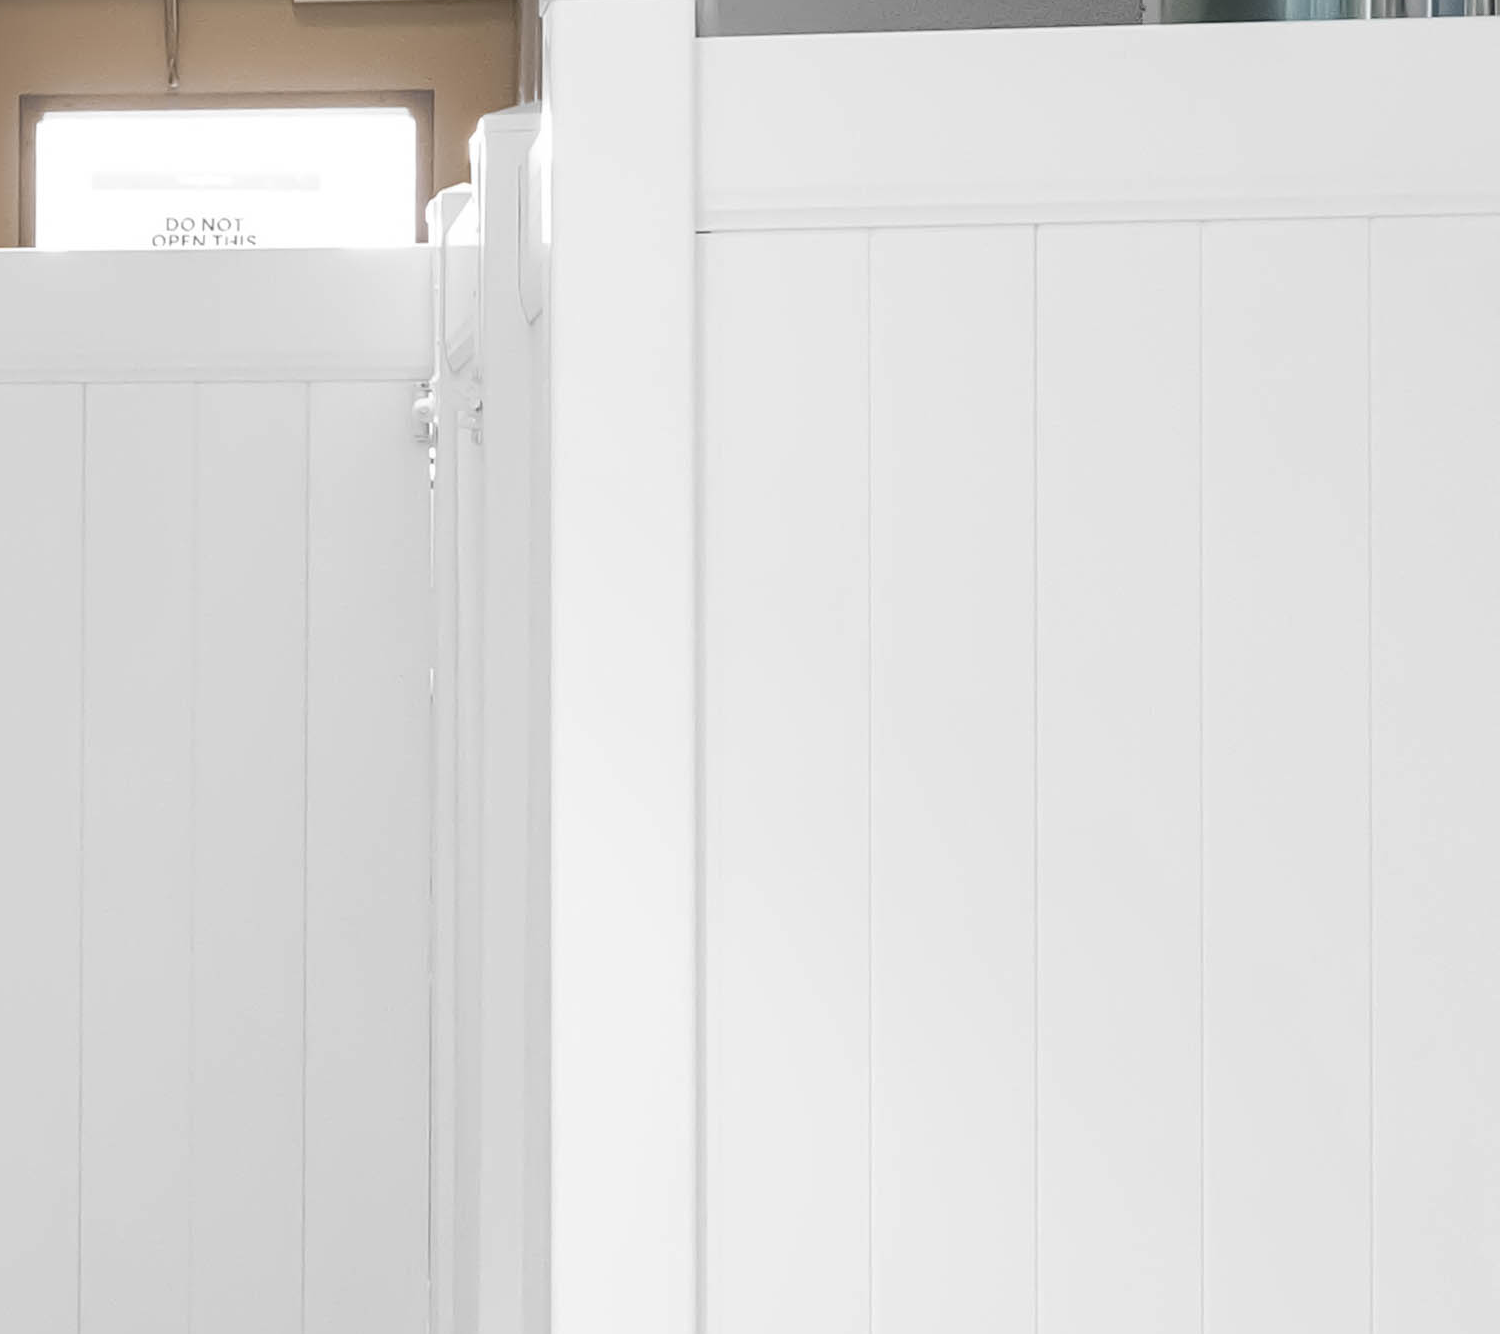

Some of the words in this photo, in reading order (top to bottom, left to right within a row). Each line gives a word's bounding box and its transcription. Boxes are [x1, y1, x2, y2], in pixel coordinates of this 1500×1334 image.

[166, 217, 195, 232] DO
[202, 217, 244, 232] NOT
[152, 234, 206, 247] OPEN
[213, 234, 257, 247] THIS
